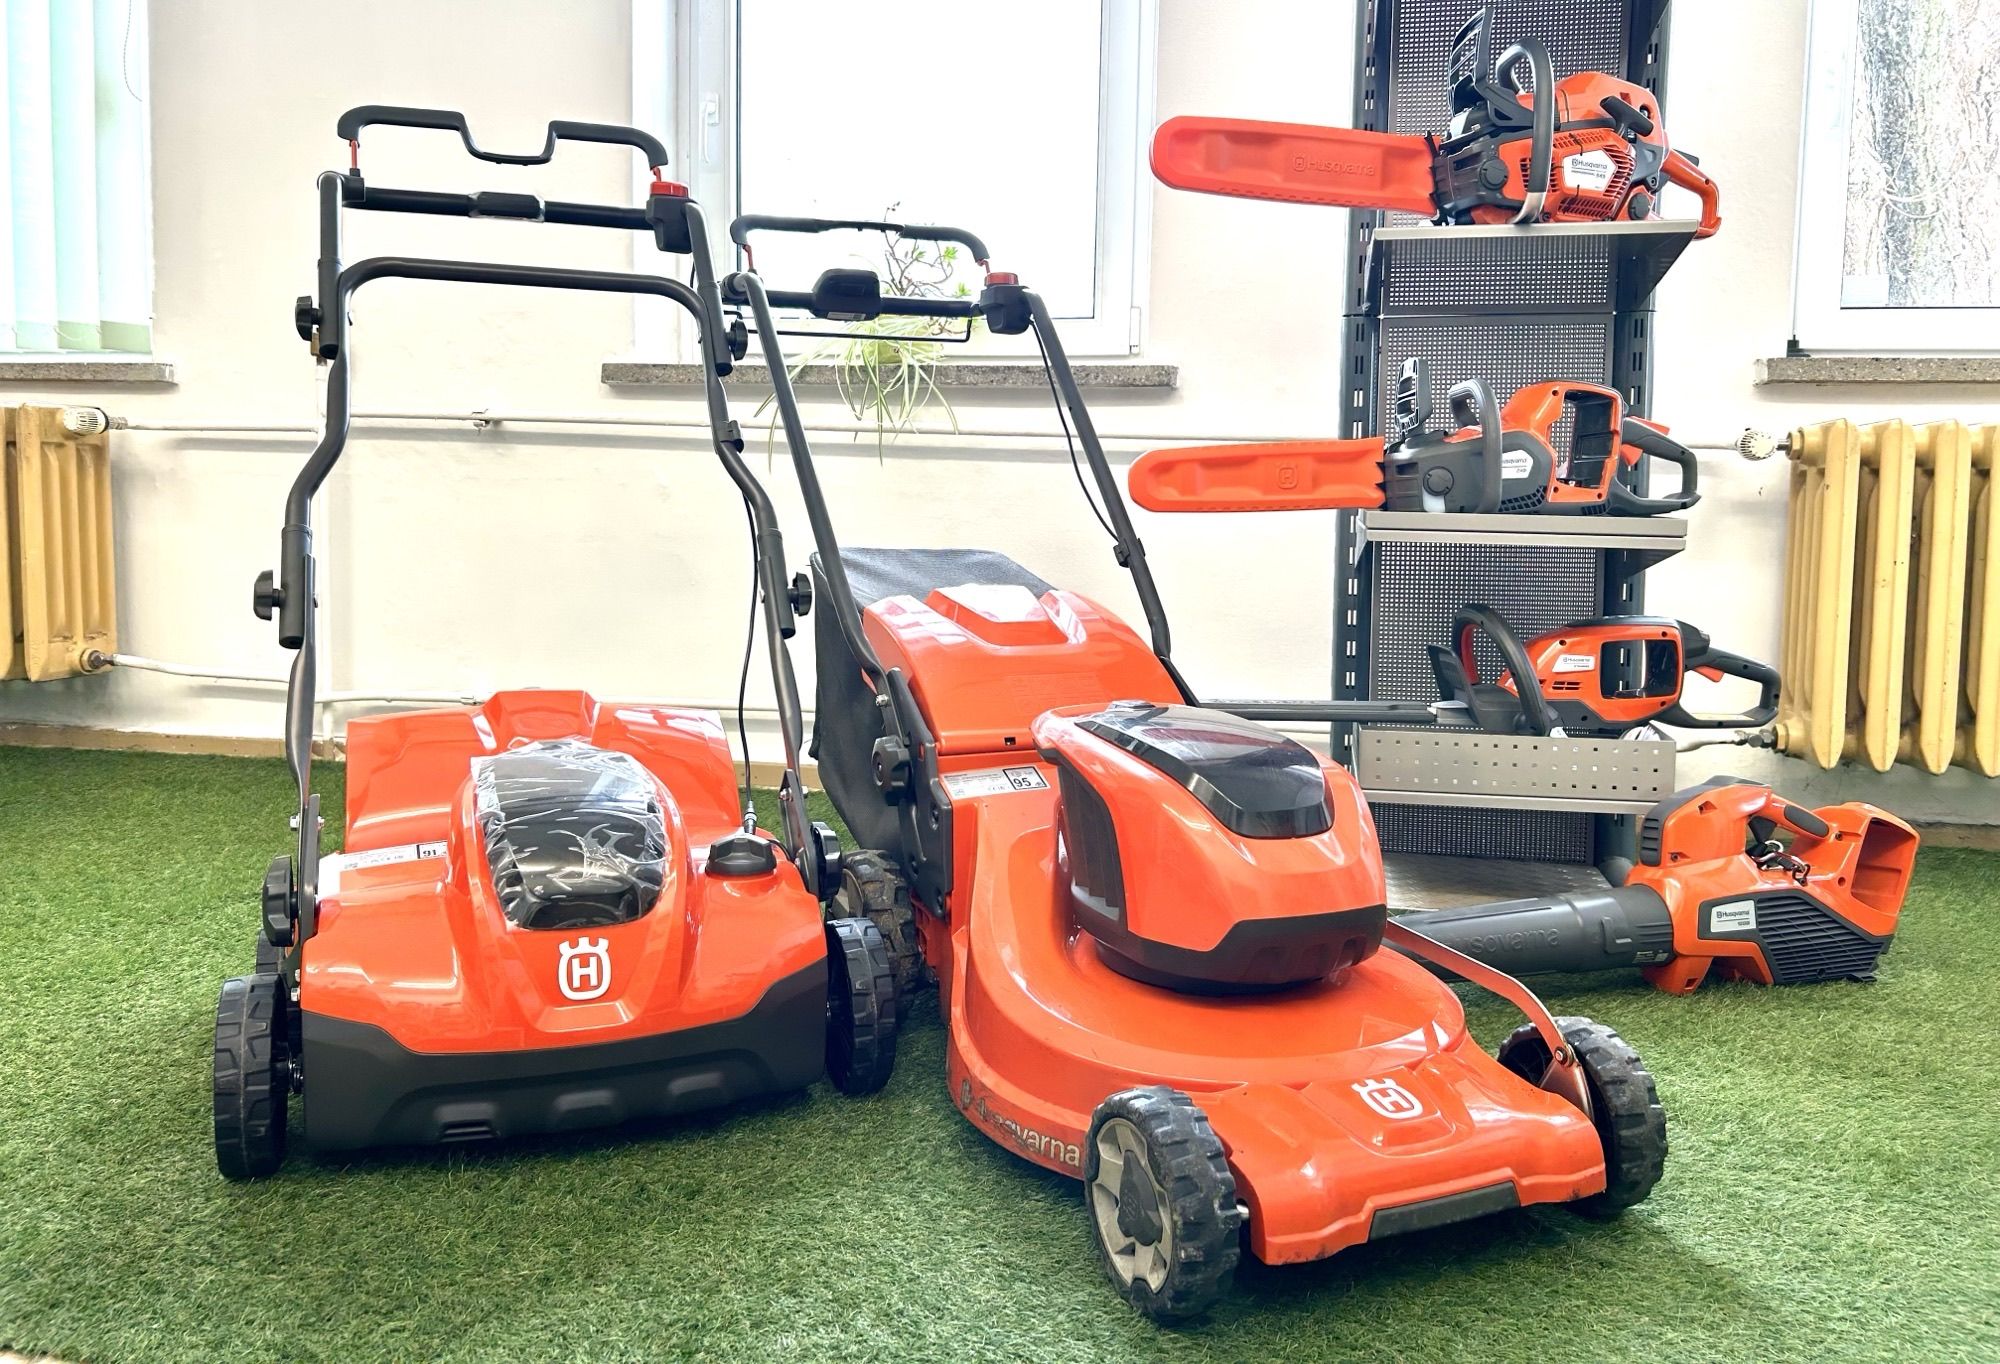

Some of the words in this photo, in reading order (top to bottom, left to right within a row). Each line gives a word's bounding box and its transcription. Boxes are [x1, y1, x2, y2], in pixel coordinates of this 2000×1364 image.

[1307, 159, 1375, 177] Husqvarna
[1579, 160, 1608, 170] Husqvarna
[1013, 777, 1032, 788] 95
[422, 849, 437, 857] 91
